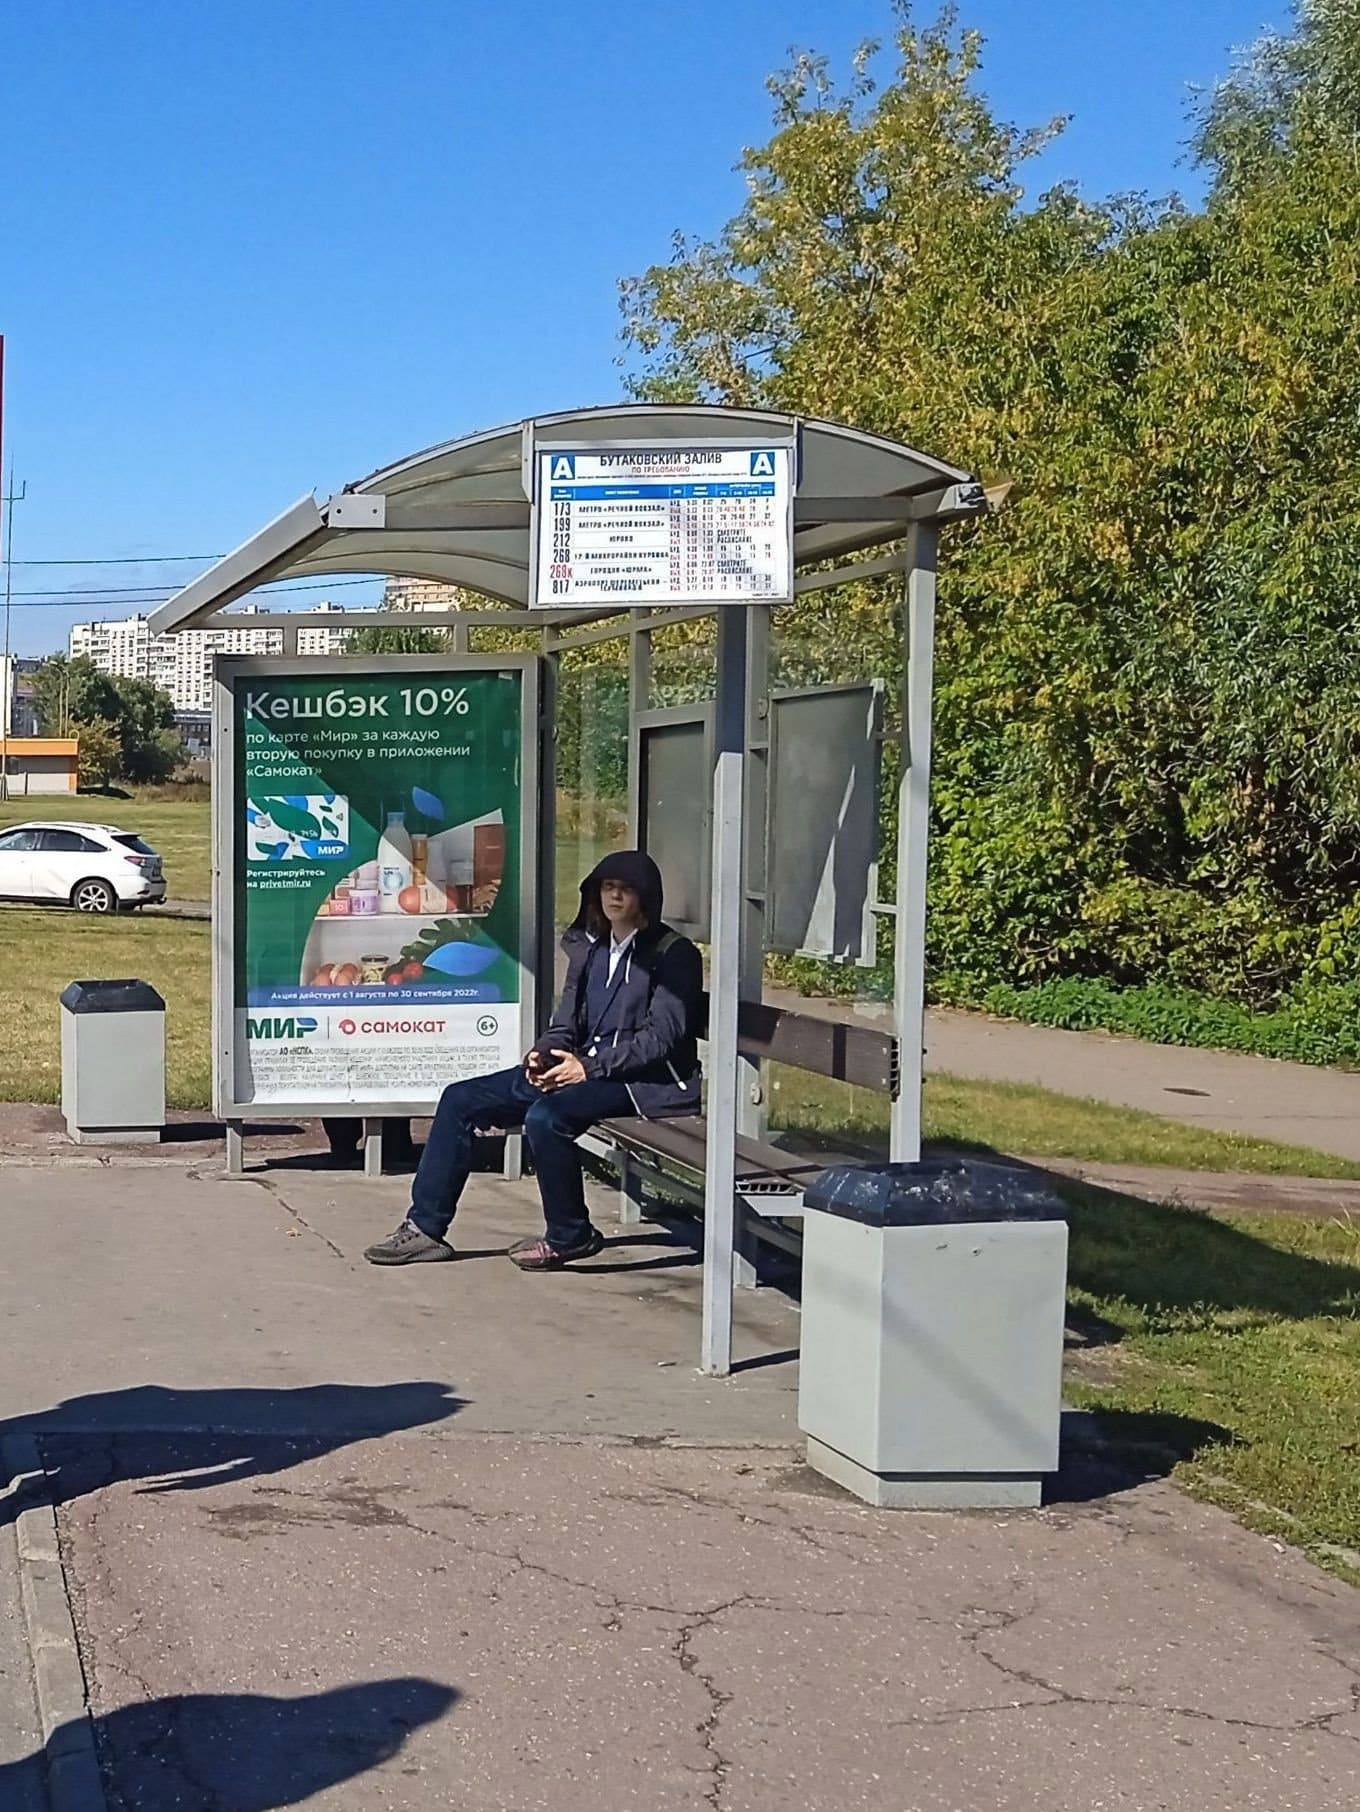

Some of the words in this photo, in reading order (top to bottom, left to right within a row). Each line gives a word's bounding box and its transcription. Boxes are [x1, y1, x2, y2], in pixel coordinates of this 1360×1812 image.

[600, 451, 681, 466] БУТАКОВСКИЙ
[684, 453, 722, 465] ЗАЛИВ
[751, 453, 774, 475] А
[552, 456, 574, 479] А
[631, 466, 642, 474] ПО
[643, 465, 690, 474] ТРЕБОВАНИЮ
[554, 502, 571, 516] 173
[554, 518, 571, 531] 199
[553, 533, 571, 547] 212
[553, 548, 570, 563] 268
[552, 580, 570, 594] 817
[246, 689, 389, 719] Кешбэк
[400, 687, 470, 717] 10%
[246, 733, 264, 744] по
[268, 733, 309, 746] карте
[312, 730, 358, 744] «Мир»
[362, 731, 378, 741] за
[382, 729, 440, 744] каждую
[246, 750, 300, 762] вторую
[304, 748, 363, 761] покупку
[367, 748, 376, 758] в
[379, 745, 470, 760] приложении
[246, 765, 322, 777] «Самокат»
[317, 846, 344, 855] МИР
[247, 869, 326, 878] Регистрируйтесь
[260, 880, 312, 889] privetmir.ru
[271, 991, 298, 1000] Акция
[299, 991, 340, 1000] действует
[355, 991, 386, 1000] августа
[400, 990, 412, 998] 30
[413, 989, 453, 999] сентября
[246, 1017, 319, 1040] МИР
[360, 1020, 446, 1034] самокат
[479, 1020, 495, 1032] 6+
